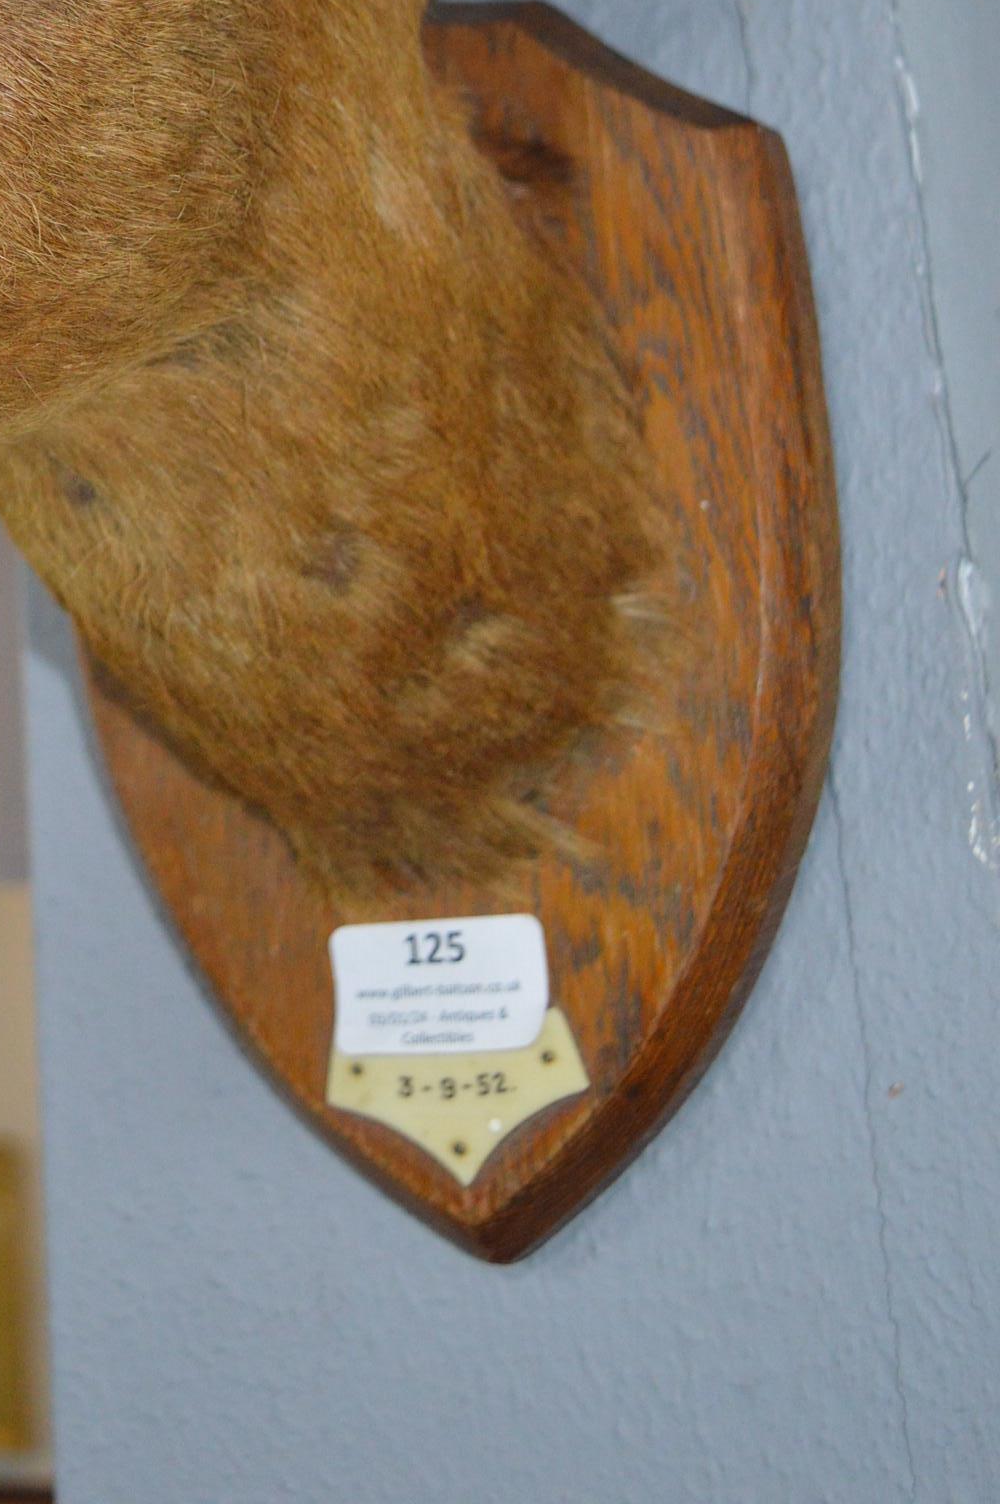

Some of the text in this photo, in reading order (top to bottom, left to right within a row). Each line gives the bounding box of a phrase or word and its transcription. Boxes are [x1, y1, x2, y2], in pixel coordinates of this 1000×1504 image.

[404, 931, 466, 965] 125
[438, 1009, 496, 1024] Antiques
[498, 1005, 509, 1020] &
